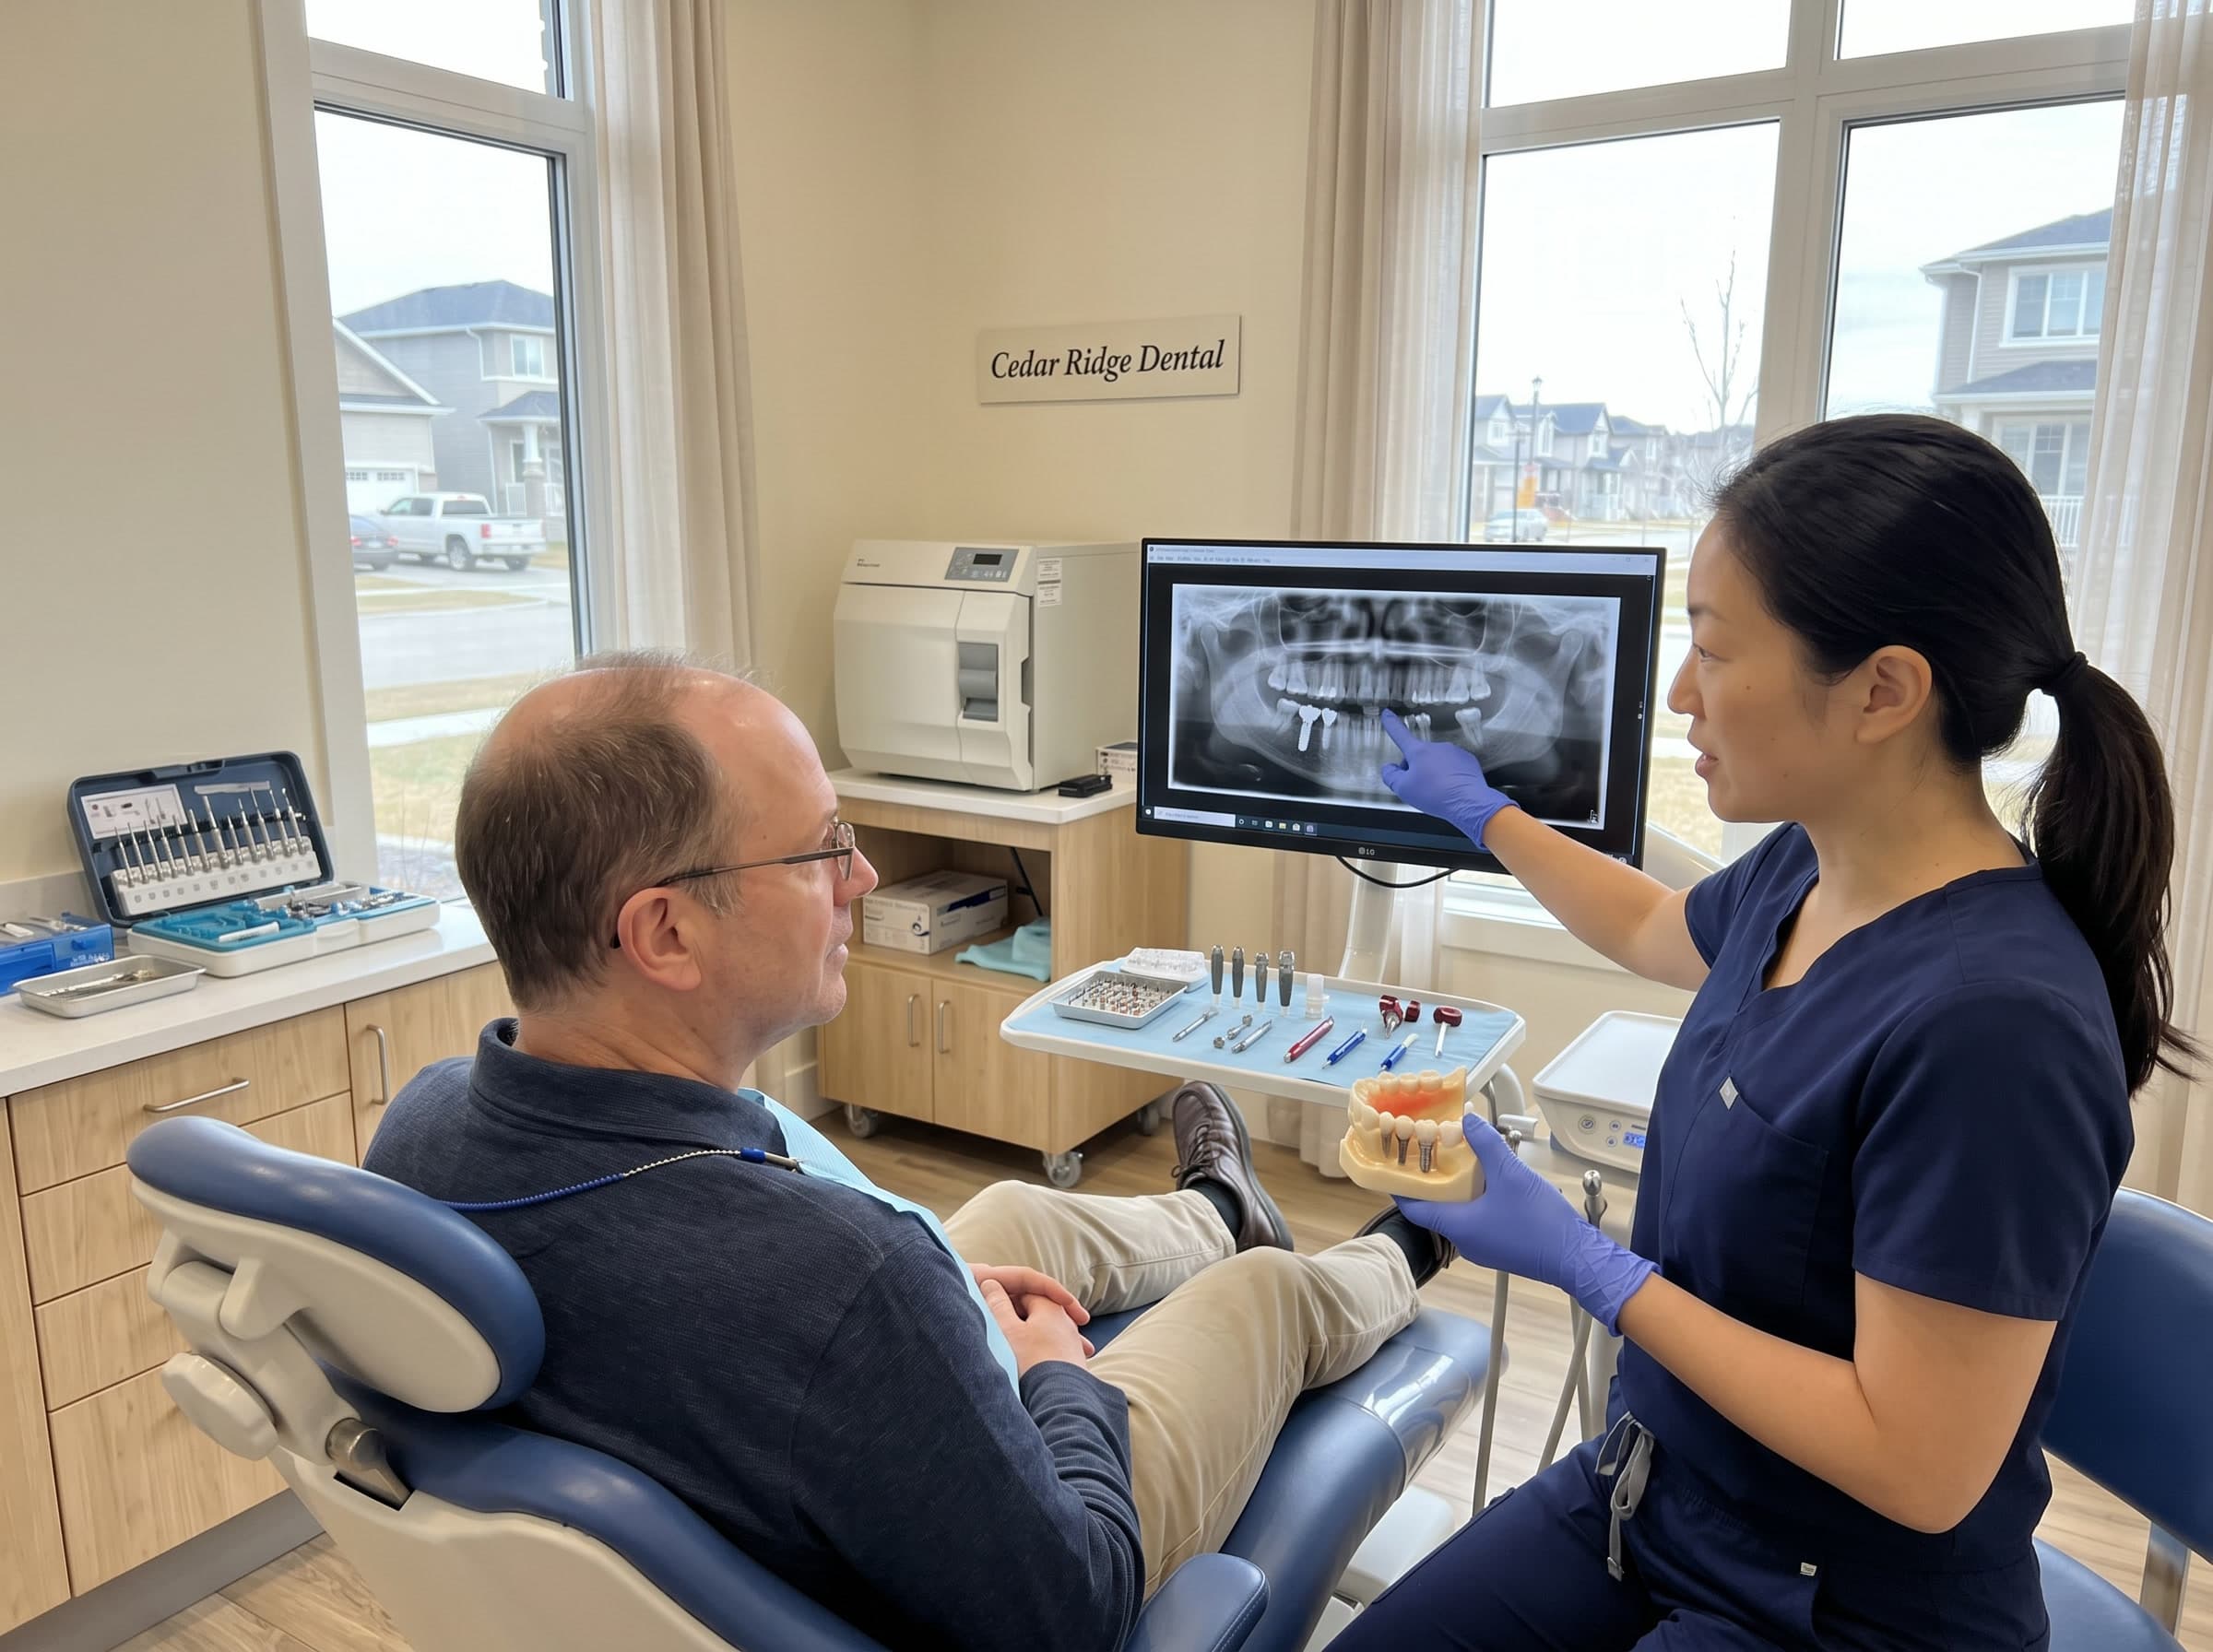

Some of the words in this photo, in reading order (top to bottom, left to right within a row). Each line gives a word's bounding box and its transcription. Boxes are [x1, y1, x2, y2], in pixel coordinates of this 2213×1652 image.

[991, 349, 1059, 379] Cedar
[1064, 346, 1131, 383] Ridge
[1137, 339, 1225, 372] Dental
